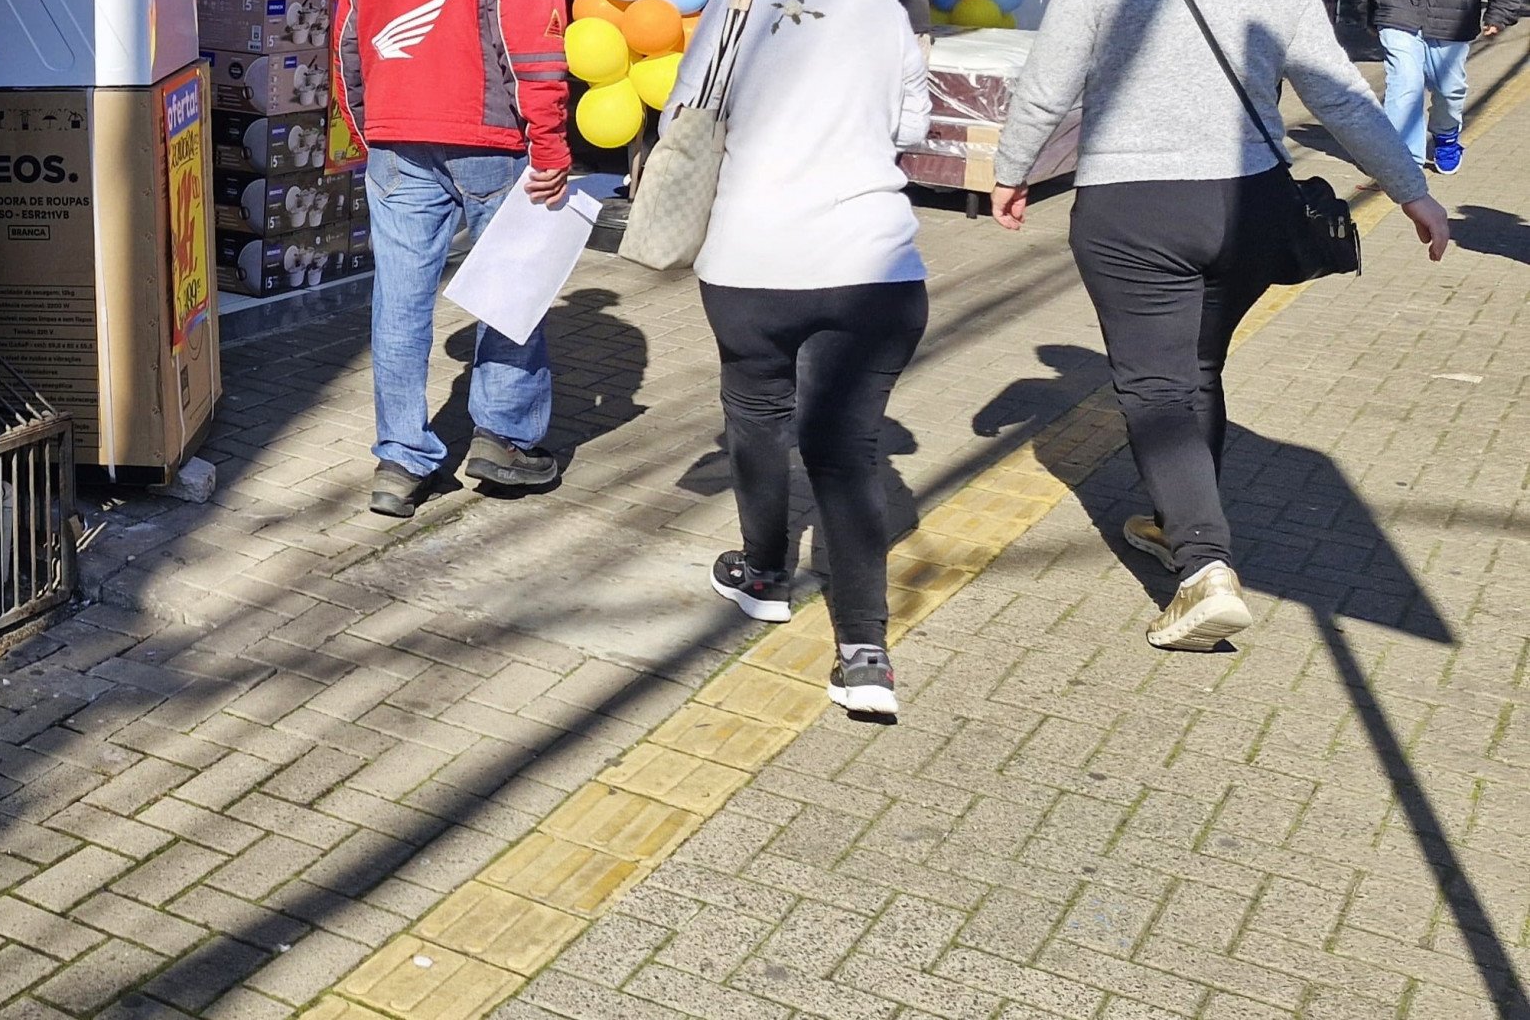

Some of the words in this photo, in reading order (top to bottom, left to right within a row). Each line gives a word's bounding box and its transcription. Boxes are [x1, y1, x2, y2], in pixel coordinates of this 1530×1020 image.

[167, 83, 198, 132] oferta!
[30, 196, 43, 206] DE
[47, 196, 90, 206] ROUPAS
[12, 228, 46, 237] BRANCA
